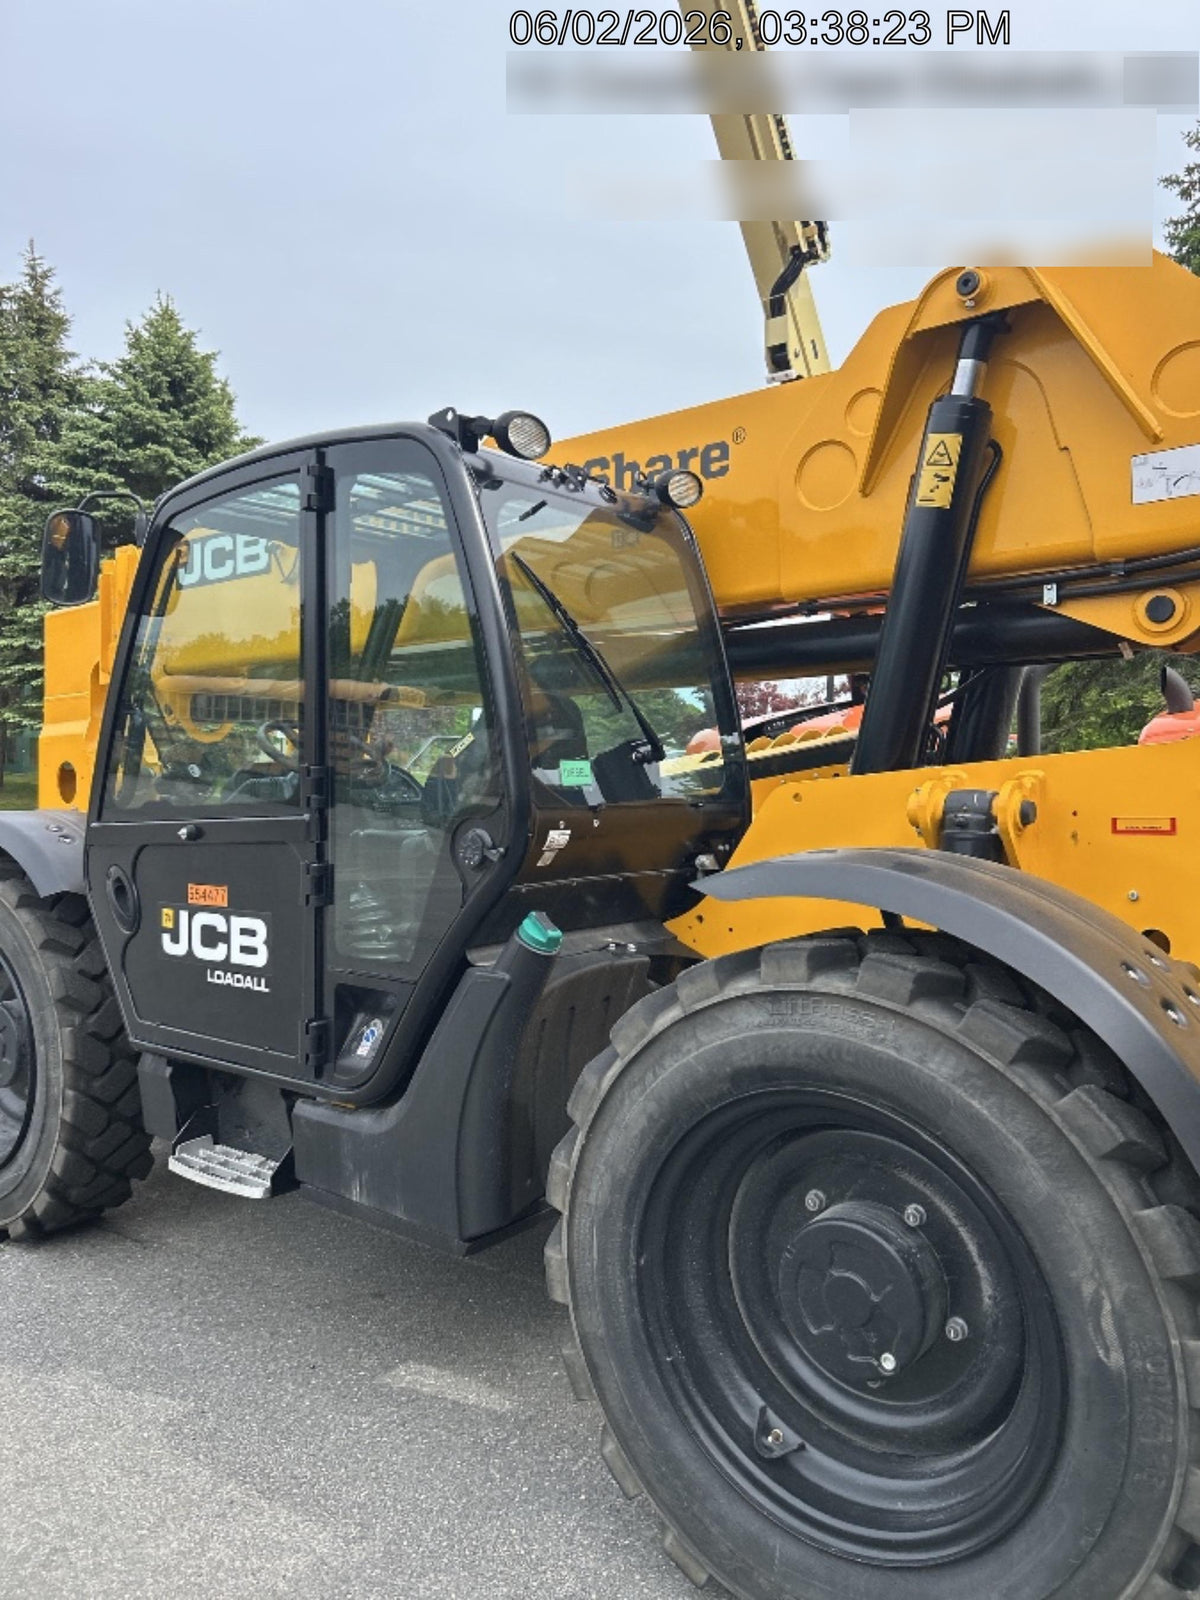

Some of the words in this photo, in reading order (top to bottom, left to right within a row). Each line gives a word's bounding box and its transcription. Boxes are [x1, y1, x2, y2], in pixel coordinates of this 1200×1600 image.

[178, 533, 269, 586] JCB
[161, 909, 269, 968] JCB
[207, 968, 270, 993] LOADALL
